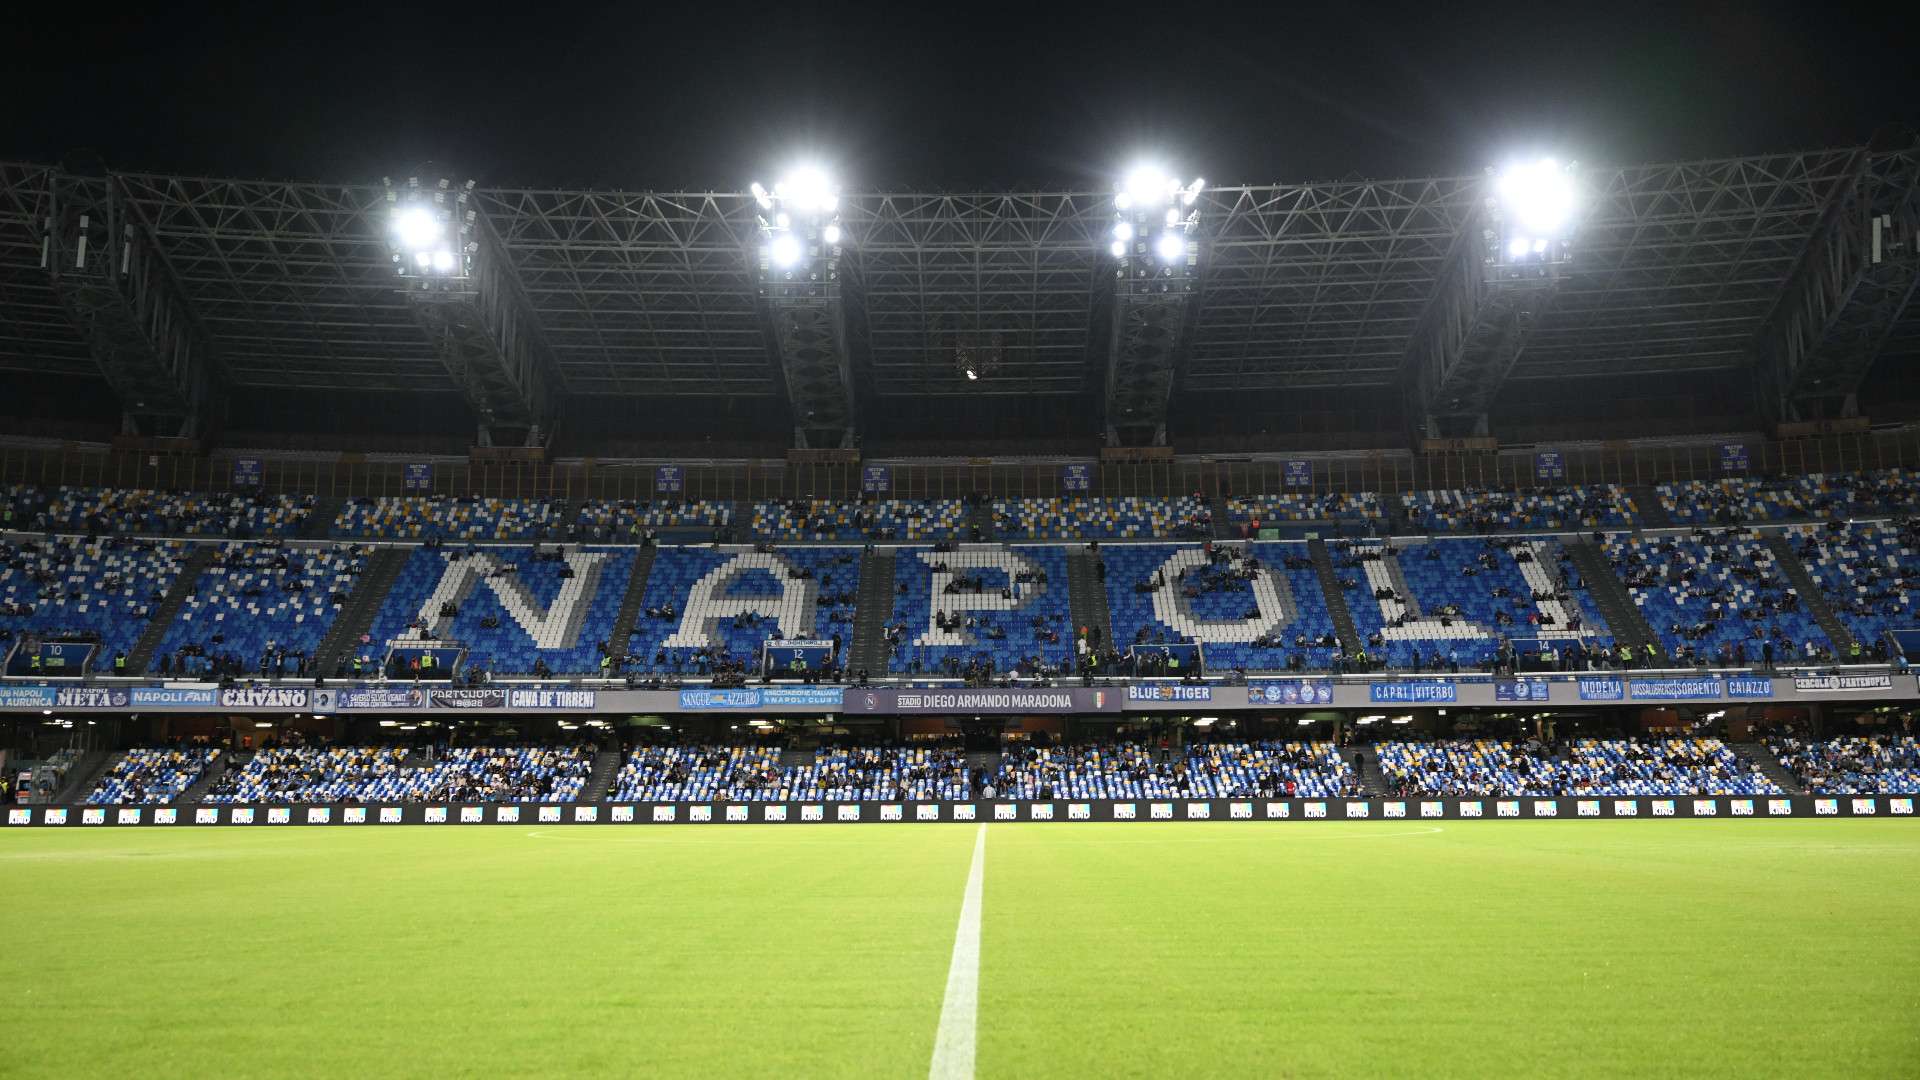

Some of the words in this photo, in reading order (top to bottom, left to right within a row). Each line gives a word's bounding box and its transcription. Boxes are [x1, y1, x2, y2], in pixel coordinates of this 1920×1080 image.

[50, 645, 62, 656] 10
[1539, 641, 1549, 650] 14
[793, 649, 804, 659] 12
[1581, 681, 1621, 693] MODENA
[1677, 682, 1720, 695] SORRENTO
[1729, 681, 1770, 694] CAIAZZO
[1795, 678, 1830, 688] CERCOLA
[1840, 676, 1890, 688] PARTENOPEA
[134, 692, 182, 702] NAPOLI
[222, 691, 306, 707] CAIVANO
[512, 690, 538, 706] CAVA
[556, 691, 594, 707] TIRRENI
[682, 692, 711, 705] SANGUE
[1129, 686, 1160, 699] BLUE
[1174, 686, 1210, 699] TIGER
[1375, 687, 1407, 699] CAPRI
[1415, 686, 1453, 699] VITERBO
[56, 692, 111, 707] META
[897, 697, 921, 706] STADIO
[924, 694, 955, 708] DIEGO
[957, 694, 1010, 708] ARMANDO
[1012, 694, 1072, 708] MARADONA
[9, 815, 31, 824] KIND
[45, 815, 67, 824] KIND
[83, 815, 105, 824] KIND
[118, 815, 140, 824] KIND
[155, 814, 176, 823] KIND
[196, 814, 218, 823] KIND
[232, 814, 254, 823] KIND
[268, 814, 290, 823] KIND
[308, 814, 330, 823] KIND
[344, 814, 366, 823] KIND
[380, 813, 402, 822] KIND
[425, 813, 447, 822] KIND
[461, 813, 483, 822] KIND
[497, 813, 519, 822] KIND
[539, 812, 561, 821] KIND
[575, 812, 597, 821] KIND
[612, 812, 633, 821] KIND
[653, 812, 675, 821] KIND
[690, 812, 711, 821] KIND
[726, 811, 748, 820] KIND
[765, 811, 786, 820] KIND
[801, 811, 823, 820] KIND
[838, 811, 860, 820] KIND
[881, 811, 902, 820] KIND
[917, 811, 938, 820] KIND
[954, 810, 975, 819] KIND
[995, 810, 1016, 819] KIND
[1032, 810, 1053, 819] KIND
[1068, 810, 1090, 819] KIND
[1114, 809, 1136, 818] KIND
[1151, 809, 1172, 818] KIND
[1188, 809, 1210, 818] KIND
[1230, 809, 1252, 818] KIND
[1267, 808, 1289, 817] KIND
[1304, 808, 1326, 817] KIND
[1347, 808, 1368, 817] KIND
[1384, 808, 1406, 817] KIND
[1421, 807, 1443, 816] KIND
[1460, 807, 1482, 816] KIND
[1497, 807, 1519, 816] KIND
[1534, 807, 1557, 816] KIND
[1577, 806, 1600, 815] KIND
[1615, 806, 1637, 815] KIND
[1652, 806, 1674, 815] KIND
[1694, 806, 1716, 815] KIND
[1731, 806, 1753, 815] KIND
[1769, 805, 1791, 814] KIND
[1815, 805, 1838, 814] KIND
[1852, 805, 1875, 814] KIND
[1890, 804, 1913, 813] KIND
